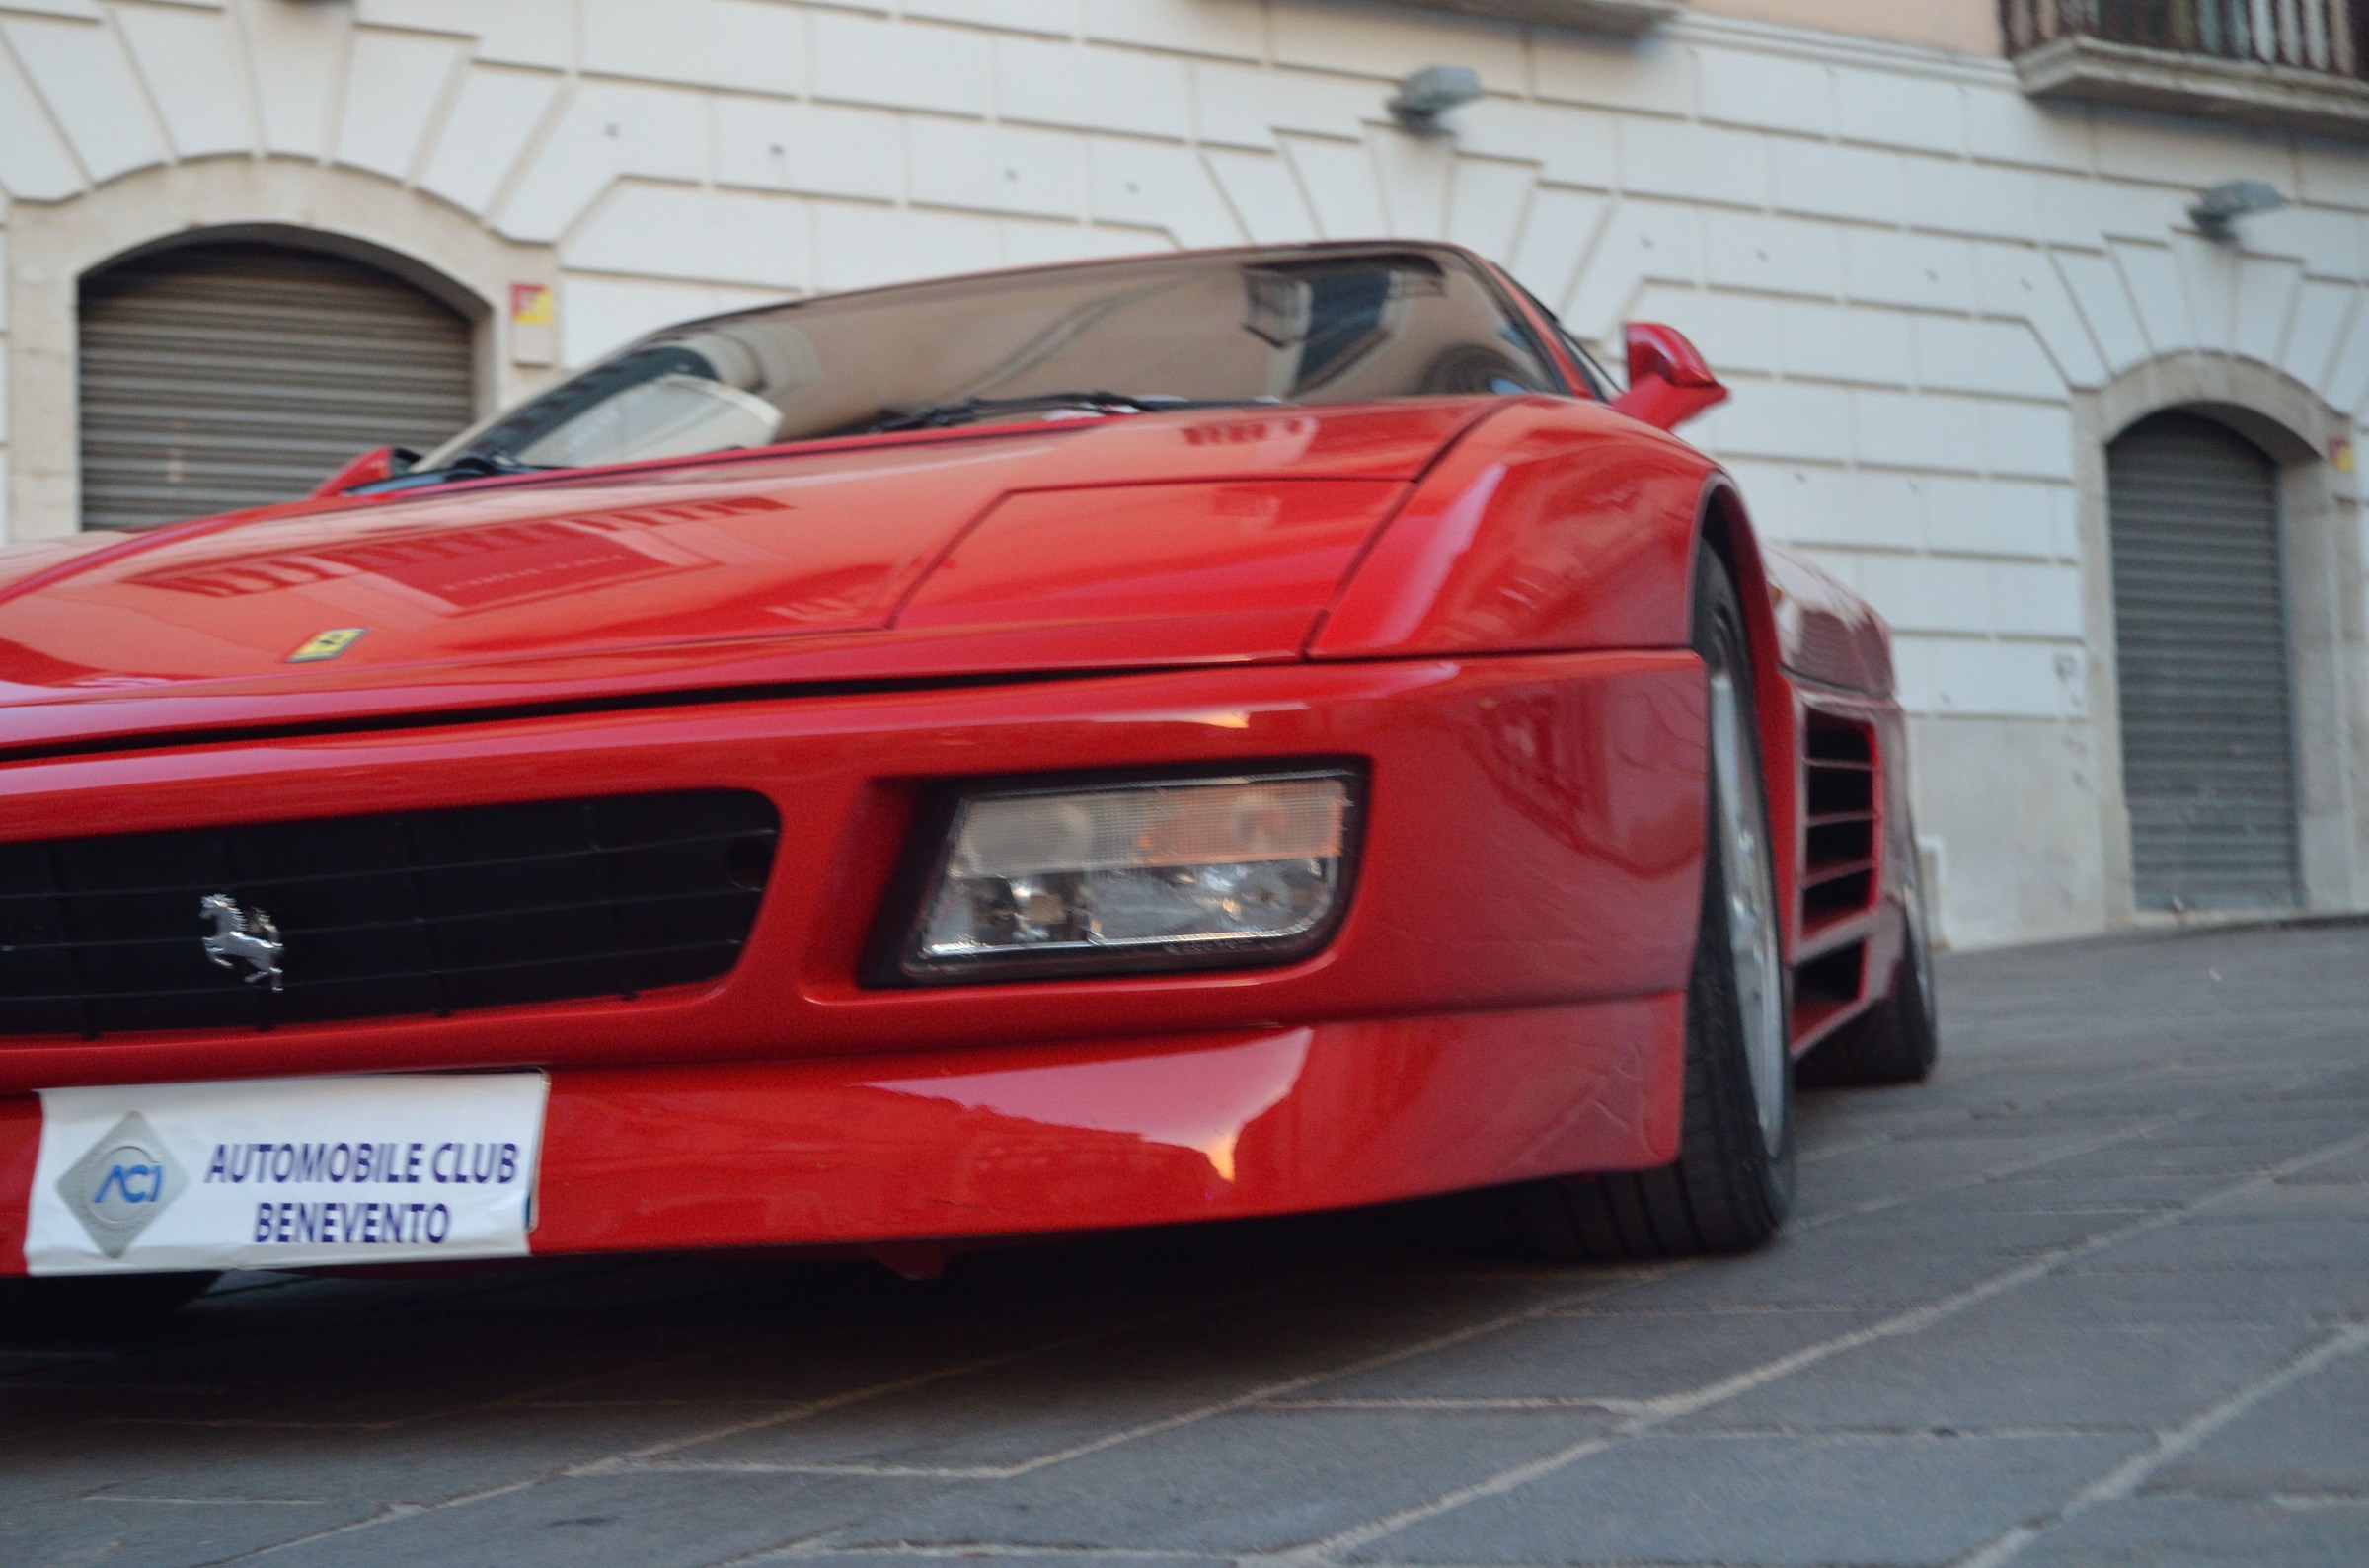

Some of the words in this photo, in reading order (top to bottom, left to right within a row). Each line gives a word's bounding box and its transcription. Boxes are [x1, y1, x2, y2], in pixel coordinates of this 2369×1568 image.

[205, 1143, 424, 1184] AUTOMOBILE
[431, 1143, 519, 1184] CLUB
[253, 1202, 450, 1244] BENEVENTO
